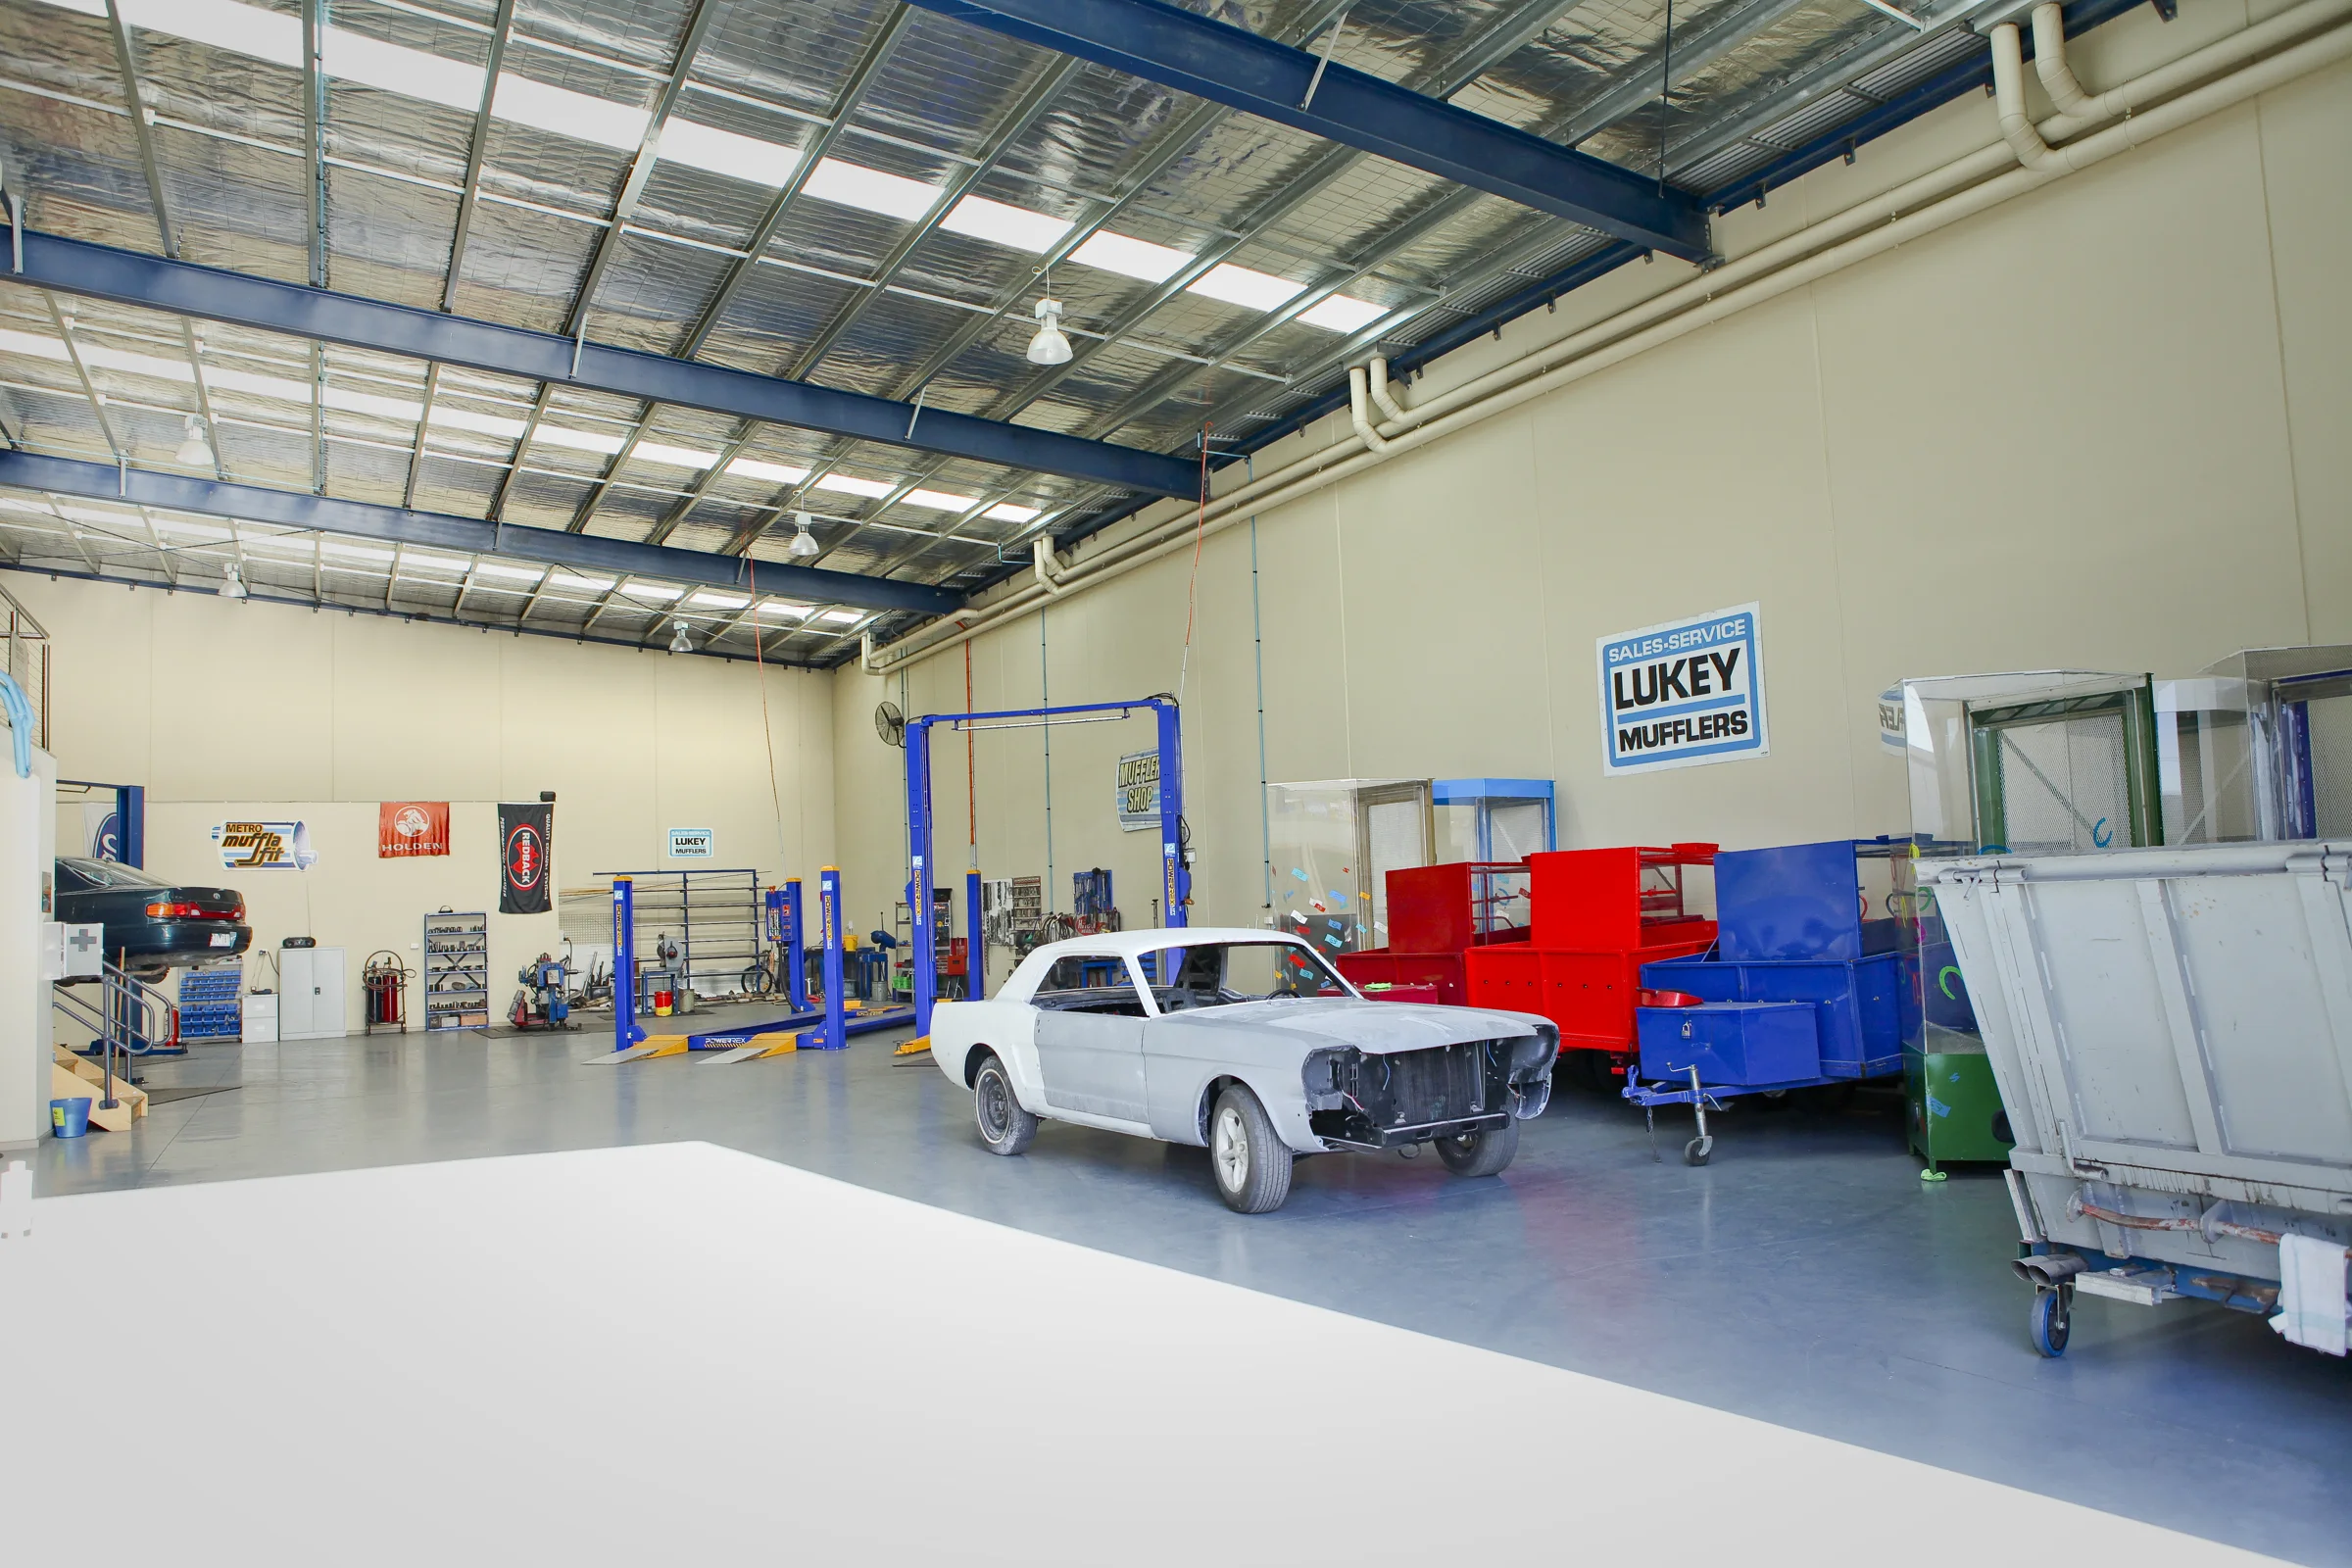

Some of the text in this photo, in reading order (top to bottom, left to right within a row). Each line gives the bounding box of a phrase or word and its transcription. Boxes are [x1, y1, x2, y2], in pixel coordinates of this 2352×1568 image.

[1614, 648, 1740, 710] LUKEY
[1619, 710, 1747, 753] MUFFLERS
[1127, 786, 1153, 813] SHOP
[225, 824, 263, 833] METRO
[221, 832, 282, 858] muffla
[382, 843, 443, 852] HOLDEN
